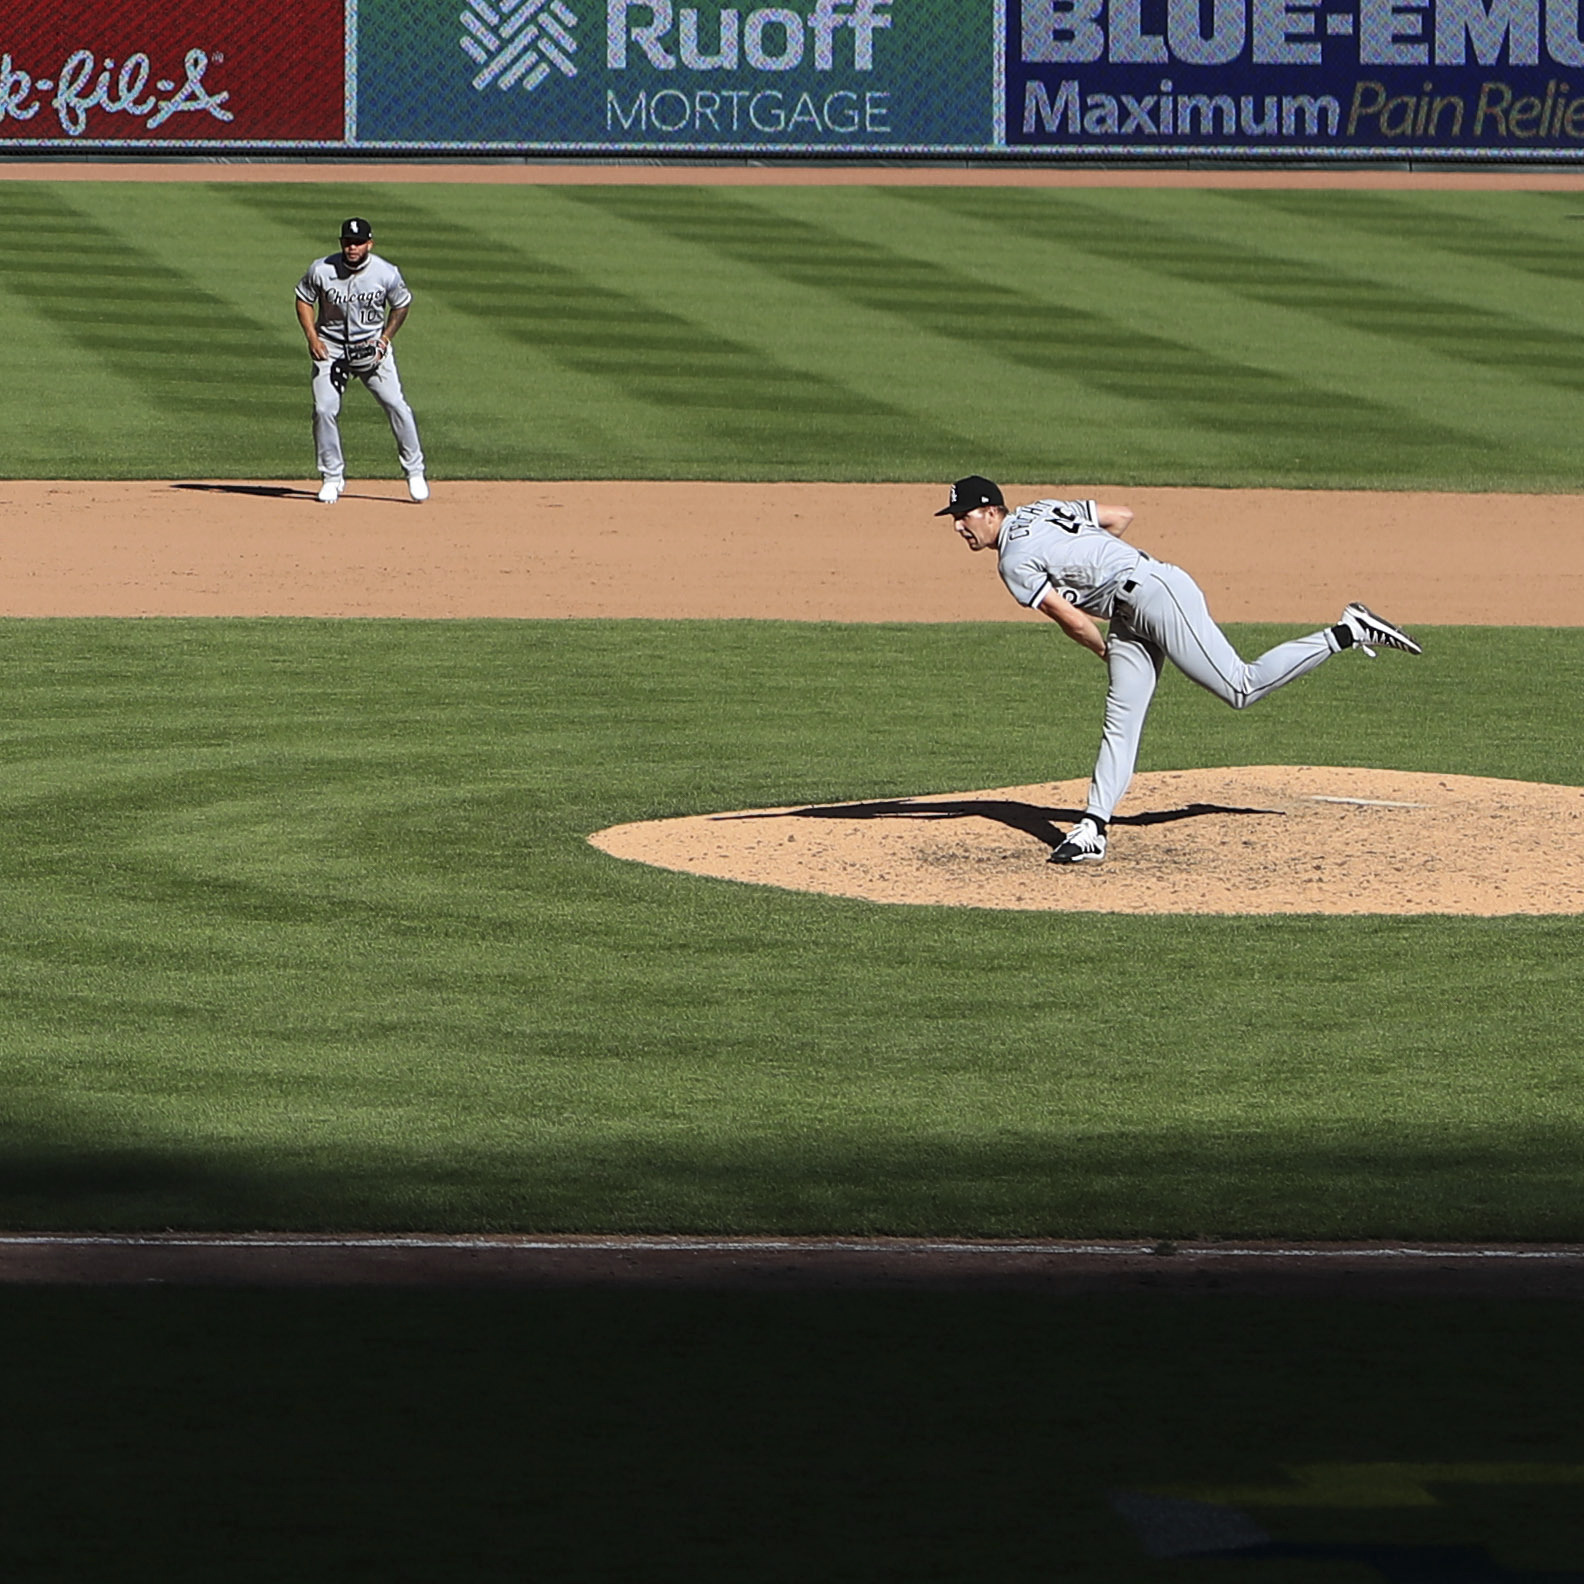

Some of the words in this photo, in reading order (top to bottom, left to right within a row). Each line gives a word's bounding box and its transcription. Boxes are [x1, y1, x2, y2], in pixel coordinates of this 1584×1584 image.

[605, 88, 892, 134] MORTGAGE
[1022, 79, 1341, 138] Maximum
[1346, 80, 1464, 138] Pain
[326, 287, 386, 308] Chicago
